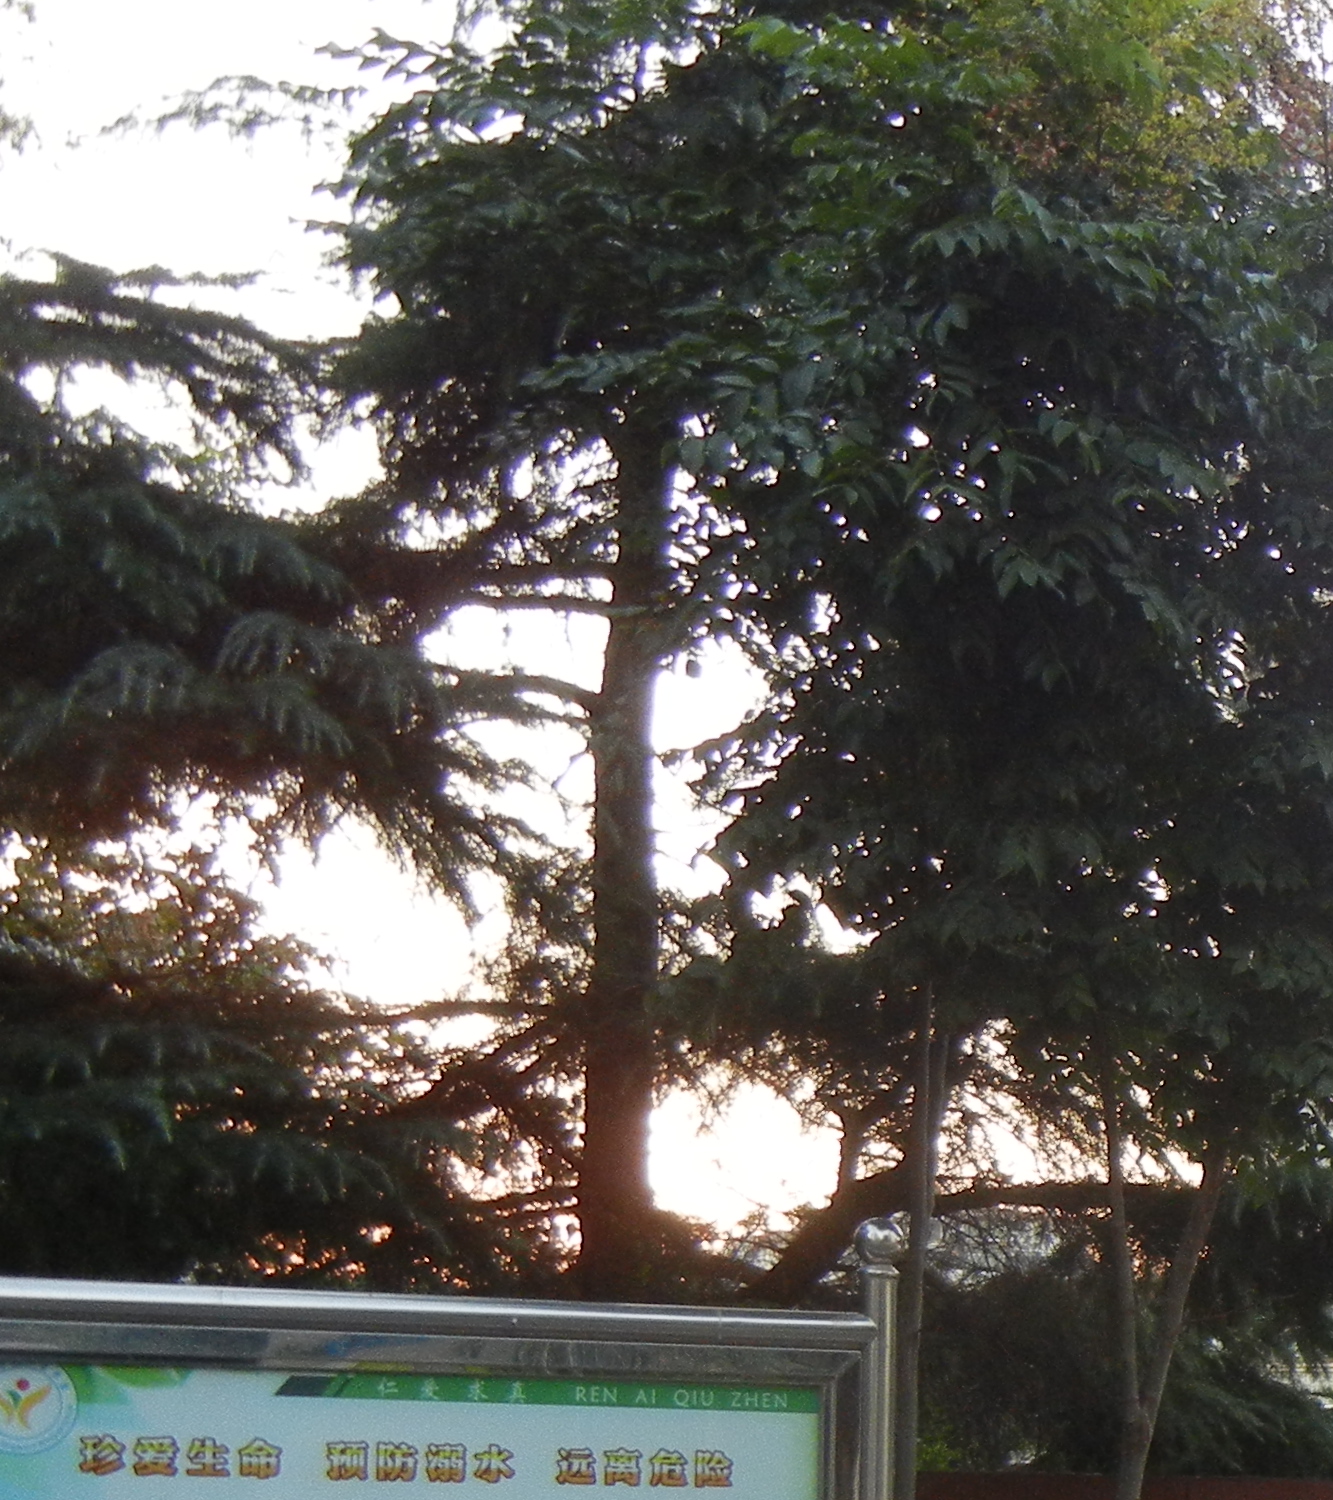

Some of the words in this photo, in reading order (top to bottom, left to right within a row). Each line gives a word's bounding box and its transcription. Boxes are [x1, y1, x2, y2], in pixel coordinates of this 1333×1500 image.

[574, 1386, 619, 1405] REN
[635, 1388, 657, 1406] AI
[673, 1388, 715, 1408] QIU
[730, 1391, 789, 1409] ZHEN
[78, 1433, 283, 1481] 珍爱生命
[325, 1438, 518, 1485] 预防溺水
[555, 1446, 736, 1489] 远离危险
